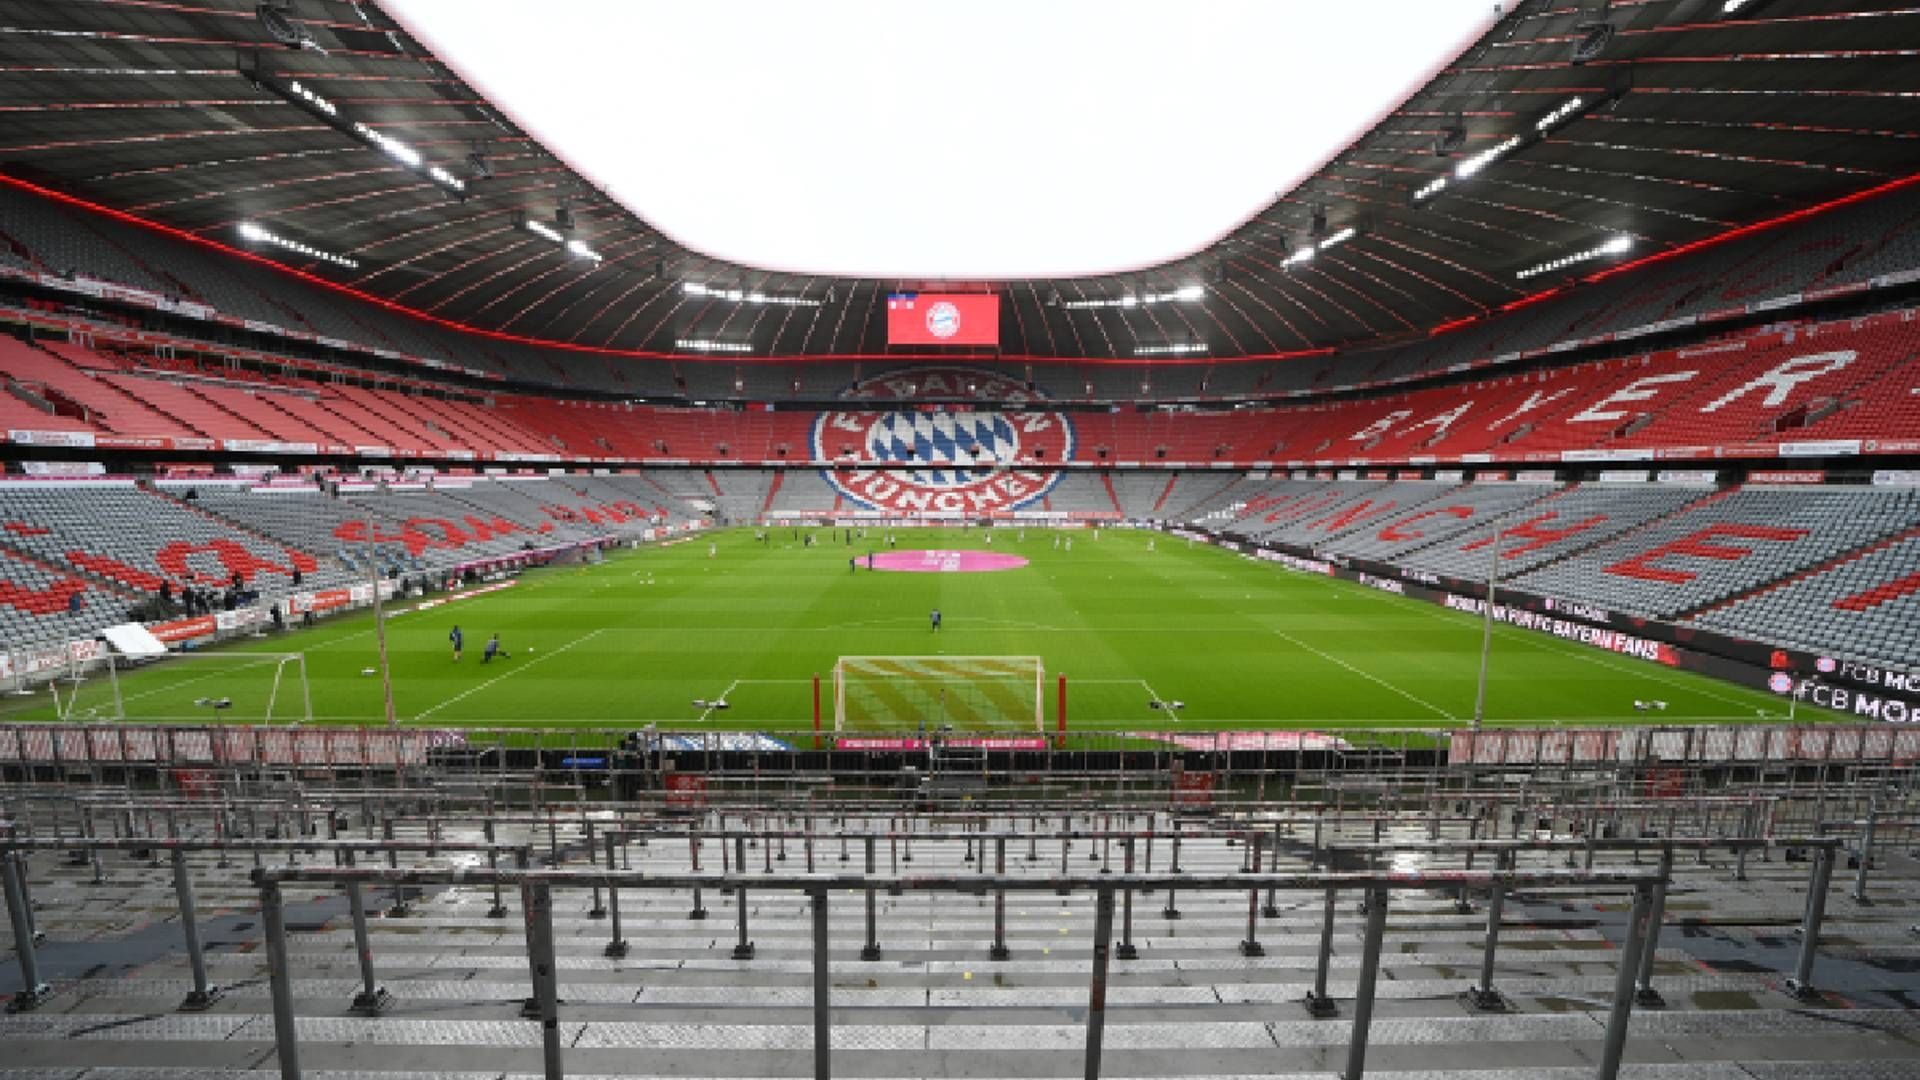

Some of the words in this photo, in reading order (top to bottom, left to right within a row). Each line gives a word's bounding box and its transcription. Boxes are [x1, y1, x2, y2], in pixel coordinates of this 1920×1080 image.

[1348, 350, 1920, 441] BAYER
[1230, 490, 1920, 612] MÜNCHE
[1553, 619, 1614, 648] BAYERN
[1614, 632, 1659, 660] FANS
[1798, 680, 1848, 709] FCB
